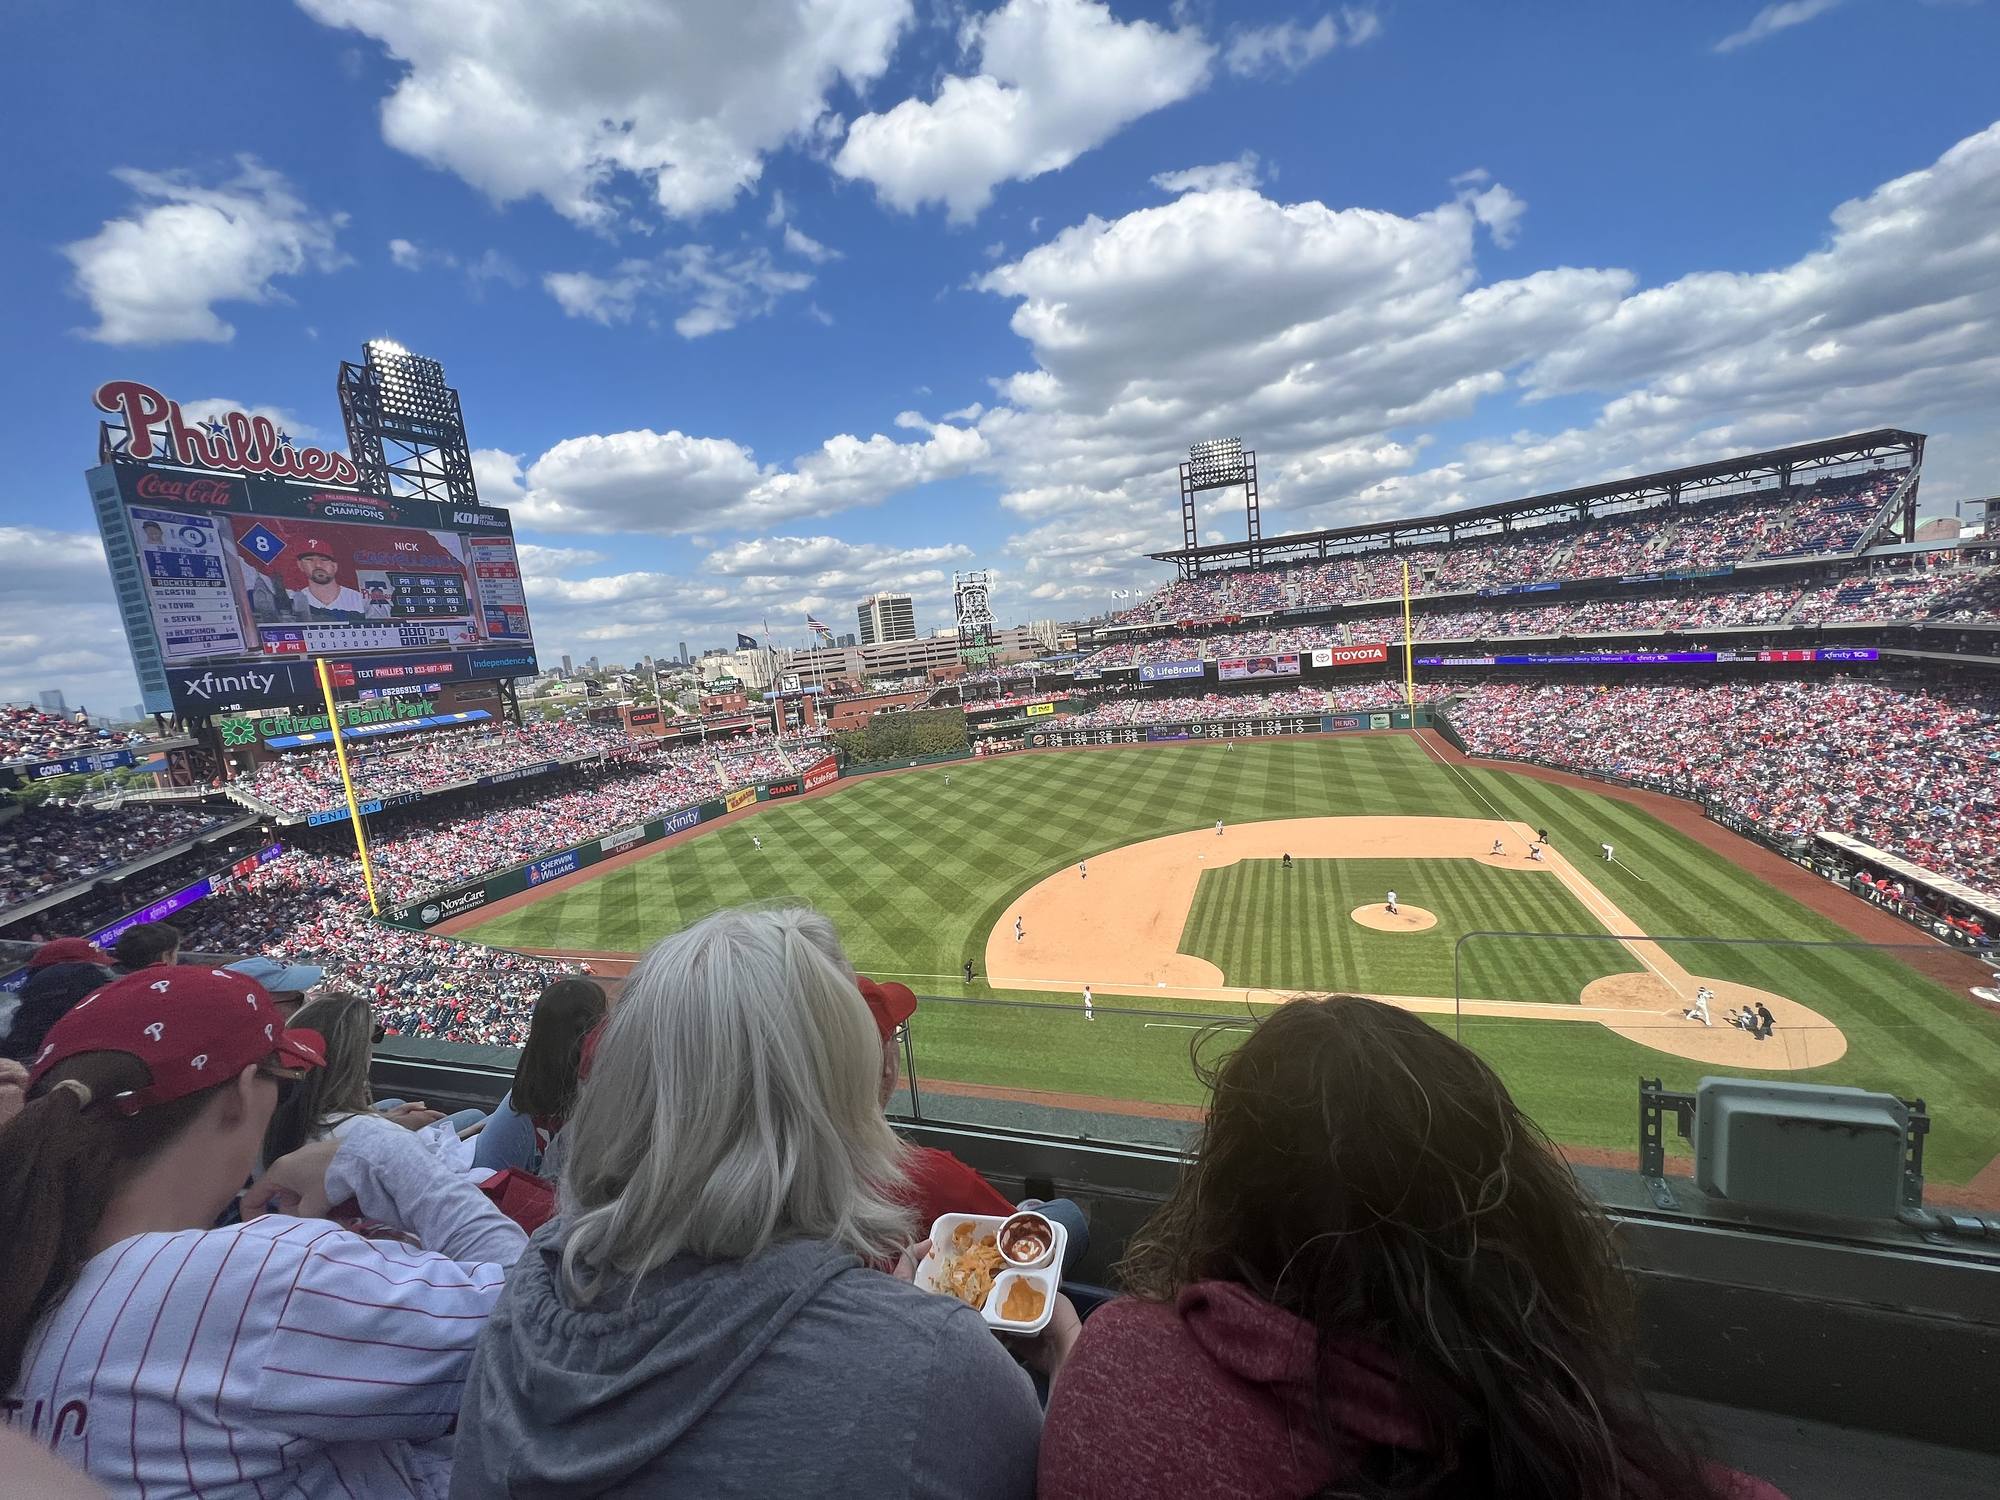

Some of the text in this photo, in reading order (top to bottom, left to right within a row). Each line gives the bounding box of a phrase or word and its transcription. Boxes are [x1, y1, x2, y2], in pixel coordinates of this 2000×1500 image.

[94, 380, 358, 484] Phillies
[137, 472, 231, 505] Coca-Cola
[324, 506, 385, 521] CHAMPIONS
[255, 536, 270, 552] 8
[394, 542, 419, 552] NICK
[171, 615, 202, 623] SERVEN
[1334, 649, 1383, 661] TOYOTA
[1824, 650, 1851, 660] xfinity
[473, 658, 526, 670] Independence
[1157, 664, 1201, 676] LifeBrand
[357, 670, 374, 678] TEXT
[375, 667, 404, 677] PHILLIES
[184, 670, 275, 700] xfinity
[259, 698, 436, 737] Citizens Bank Park
[632, 713, 657, 721] GIANT
[609, 747, 631, 756] TOYOTA
[639, 741, 659, 749] TOYOTA
[39, 764, 63, 776] GOYA
[492, 765, 548, 784] LISCIO'S BAKERY
[769, 783, 798, 796] GIANT
[309, 802, 379, 825] DENTITRY
[665, 811, 699, 832] xfinity
[540, 853, 573, 872] SHERWIN
[440, 888, 485, 912] NovaCare
